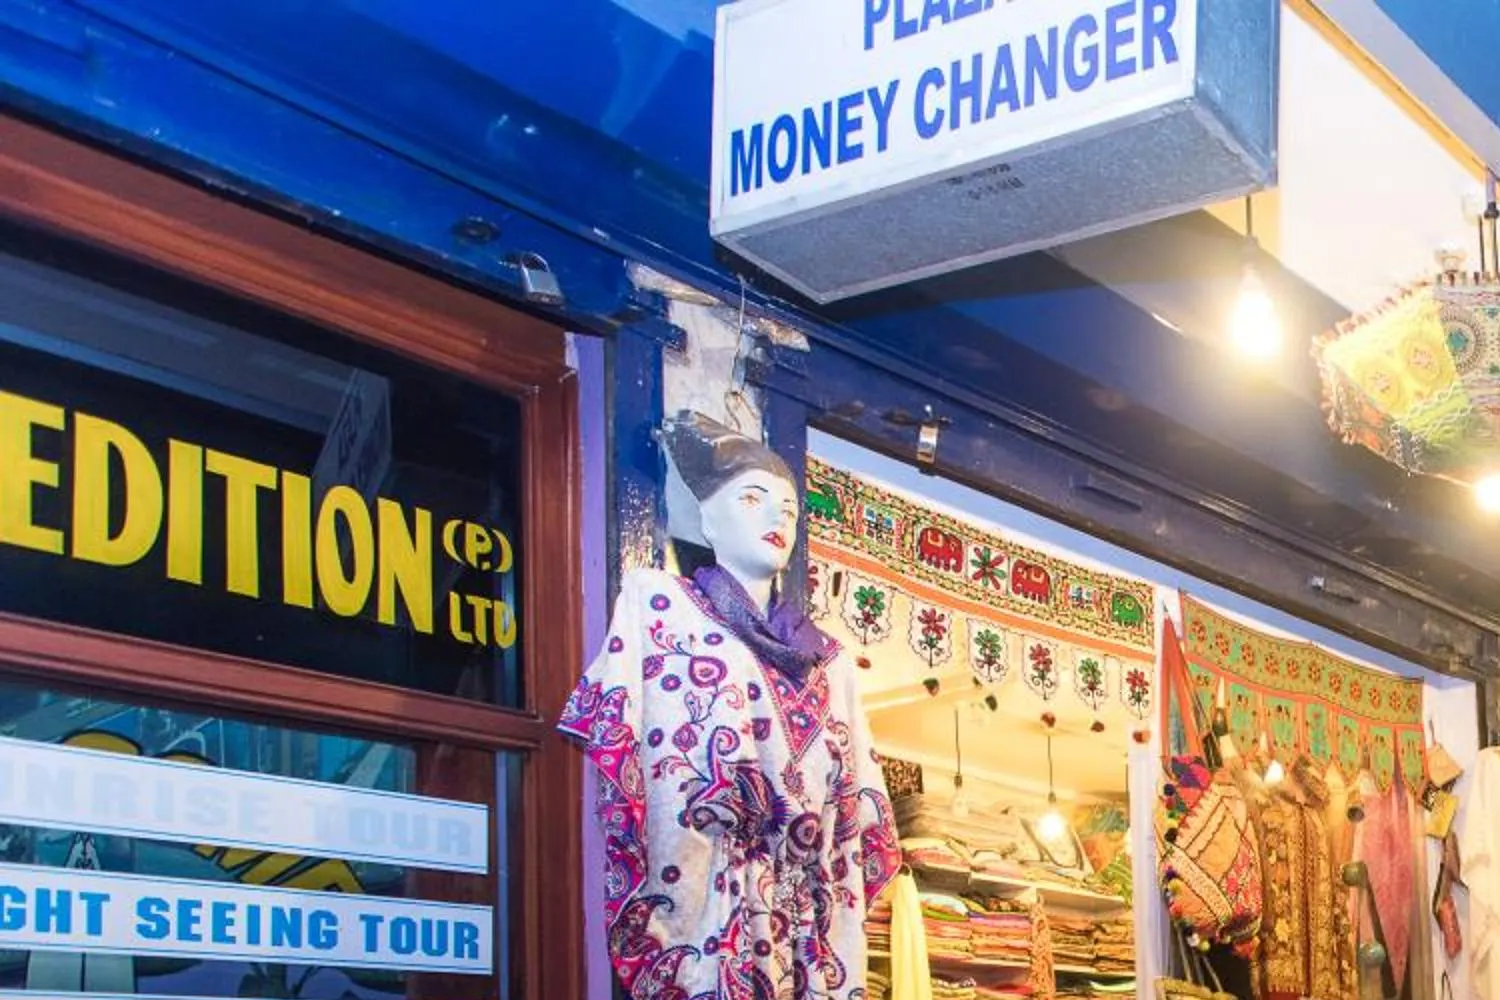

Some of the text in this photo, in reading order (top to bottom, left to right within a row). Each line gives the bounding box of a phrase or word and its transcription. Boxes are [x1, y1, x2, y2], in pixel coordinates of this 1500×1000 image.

[730, 0, 1178, 196] MONEY CHANGER
[449, 591, 516, 650] LTD
[312, 796, 472, 858] TOUR
[135, 896, 339, 951] SEEING
[359, 913, 480, 960] TOUR
